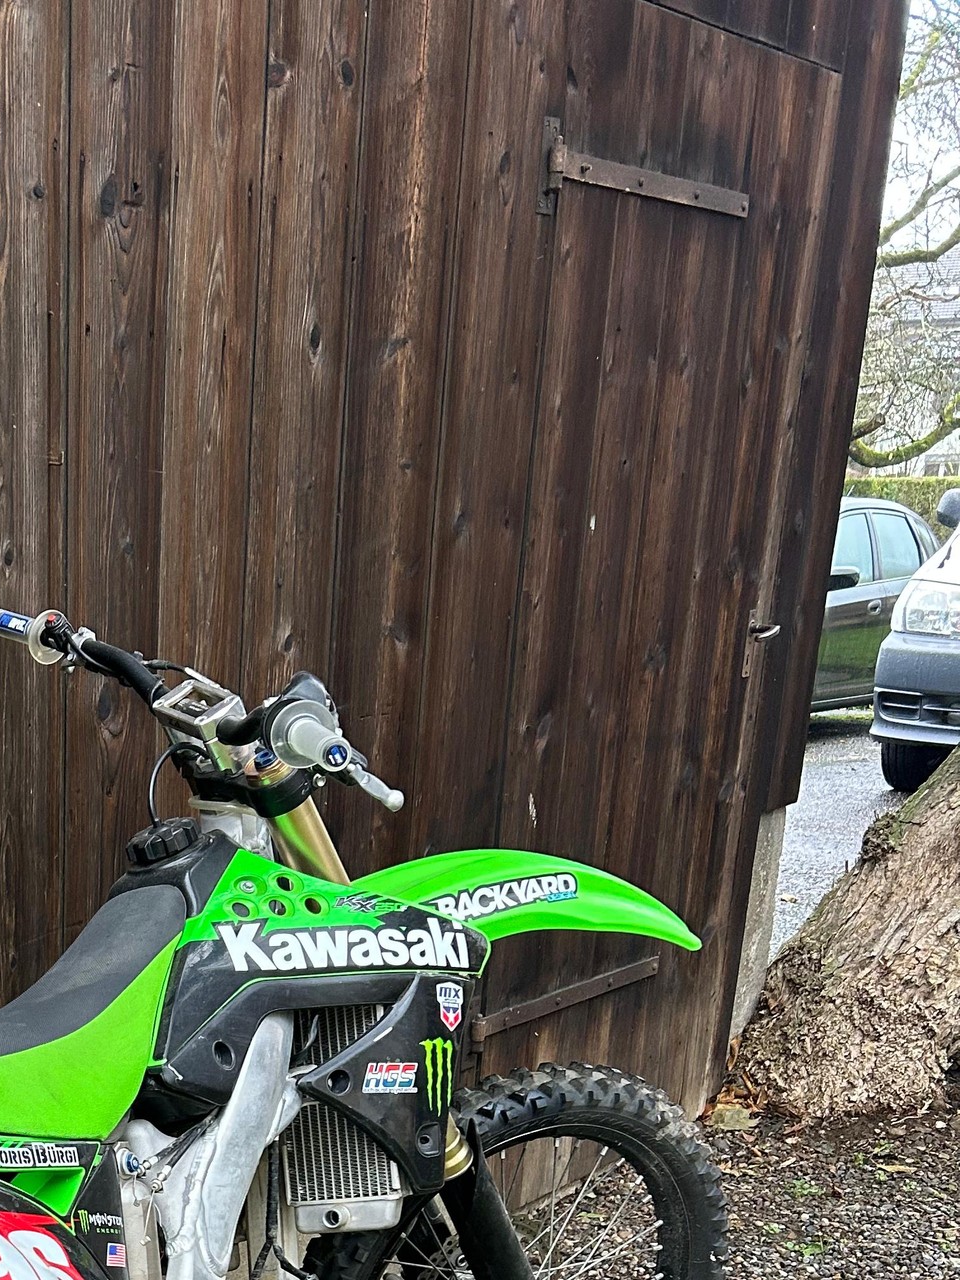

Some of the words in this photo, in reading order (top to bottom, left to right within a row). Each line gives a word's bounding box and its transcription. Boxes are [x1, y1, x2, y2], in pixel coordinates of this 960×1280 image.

[431, 874, 577, 922] BACKYARD
[217, 917, 470, 972] Kawasaki
[364, 1064, 416, 1088] HGS
